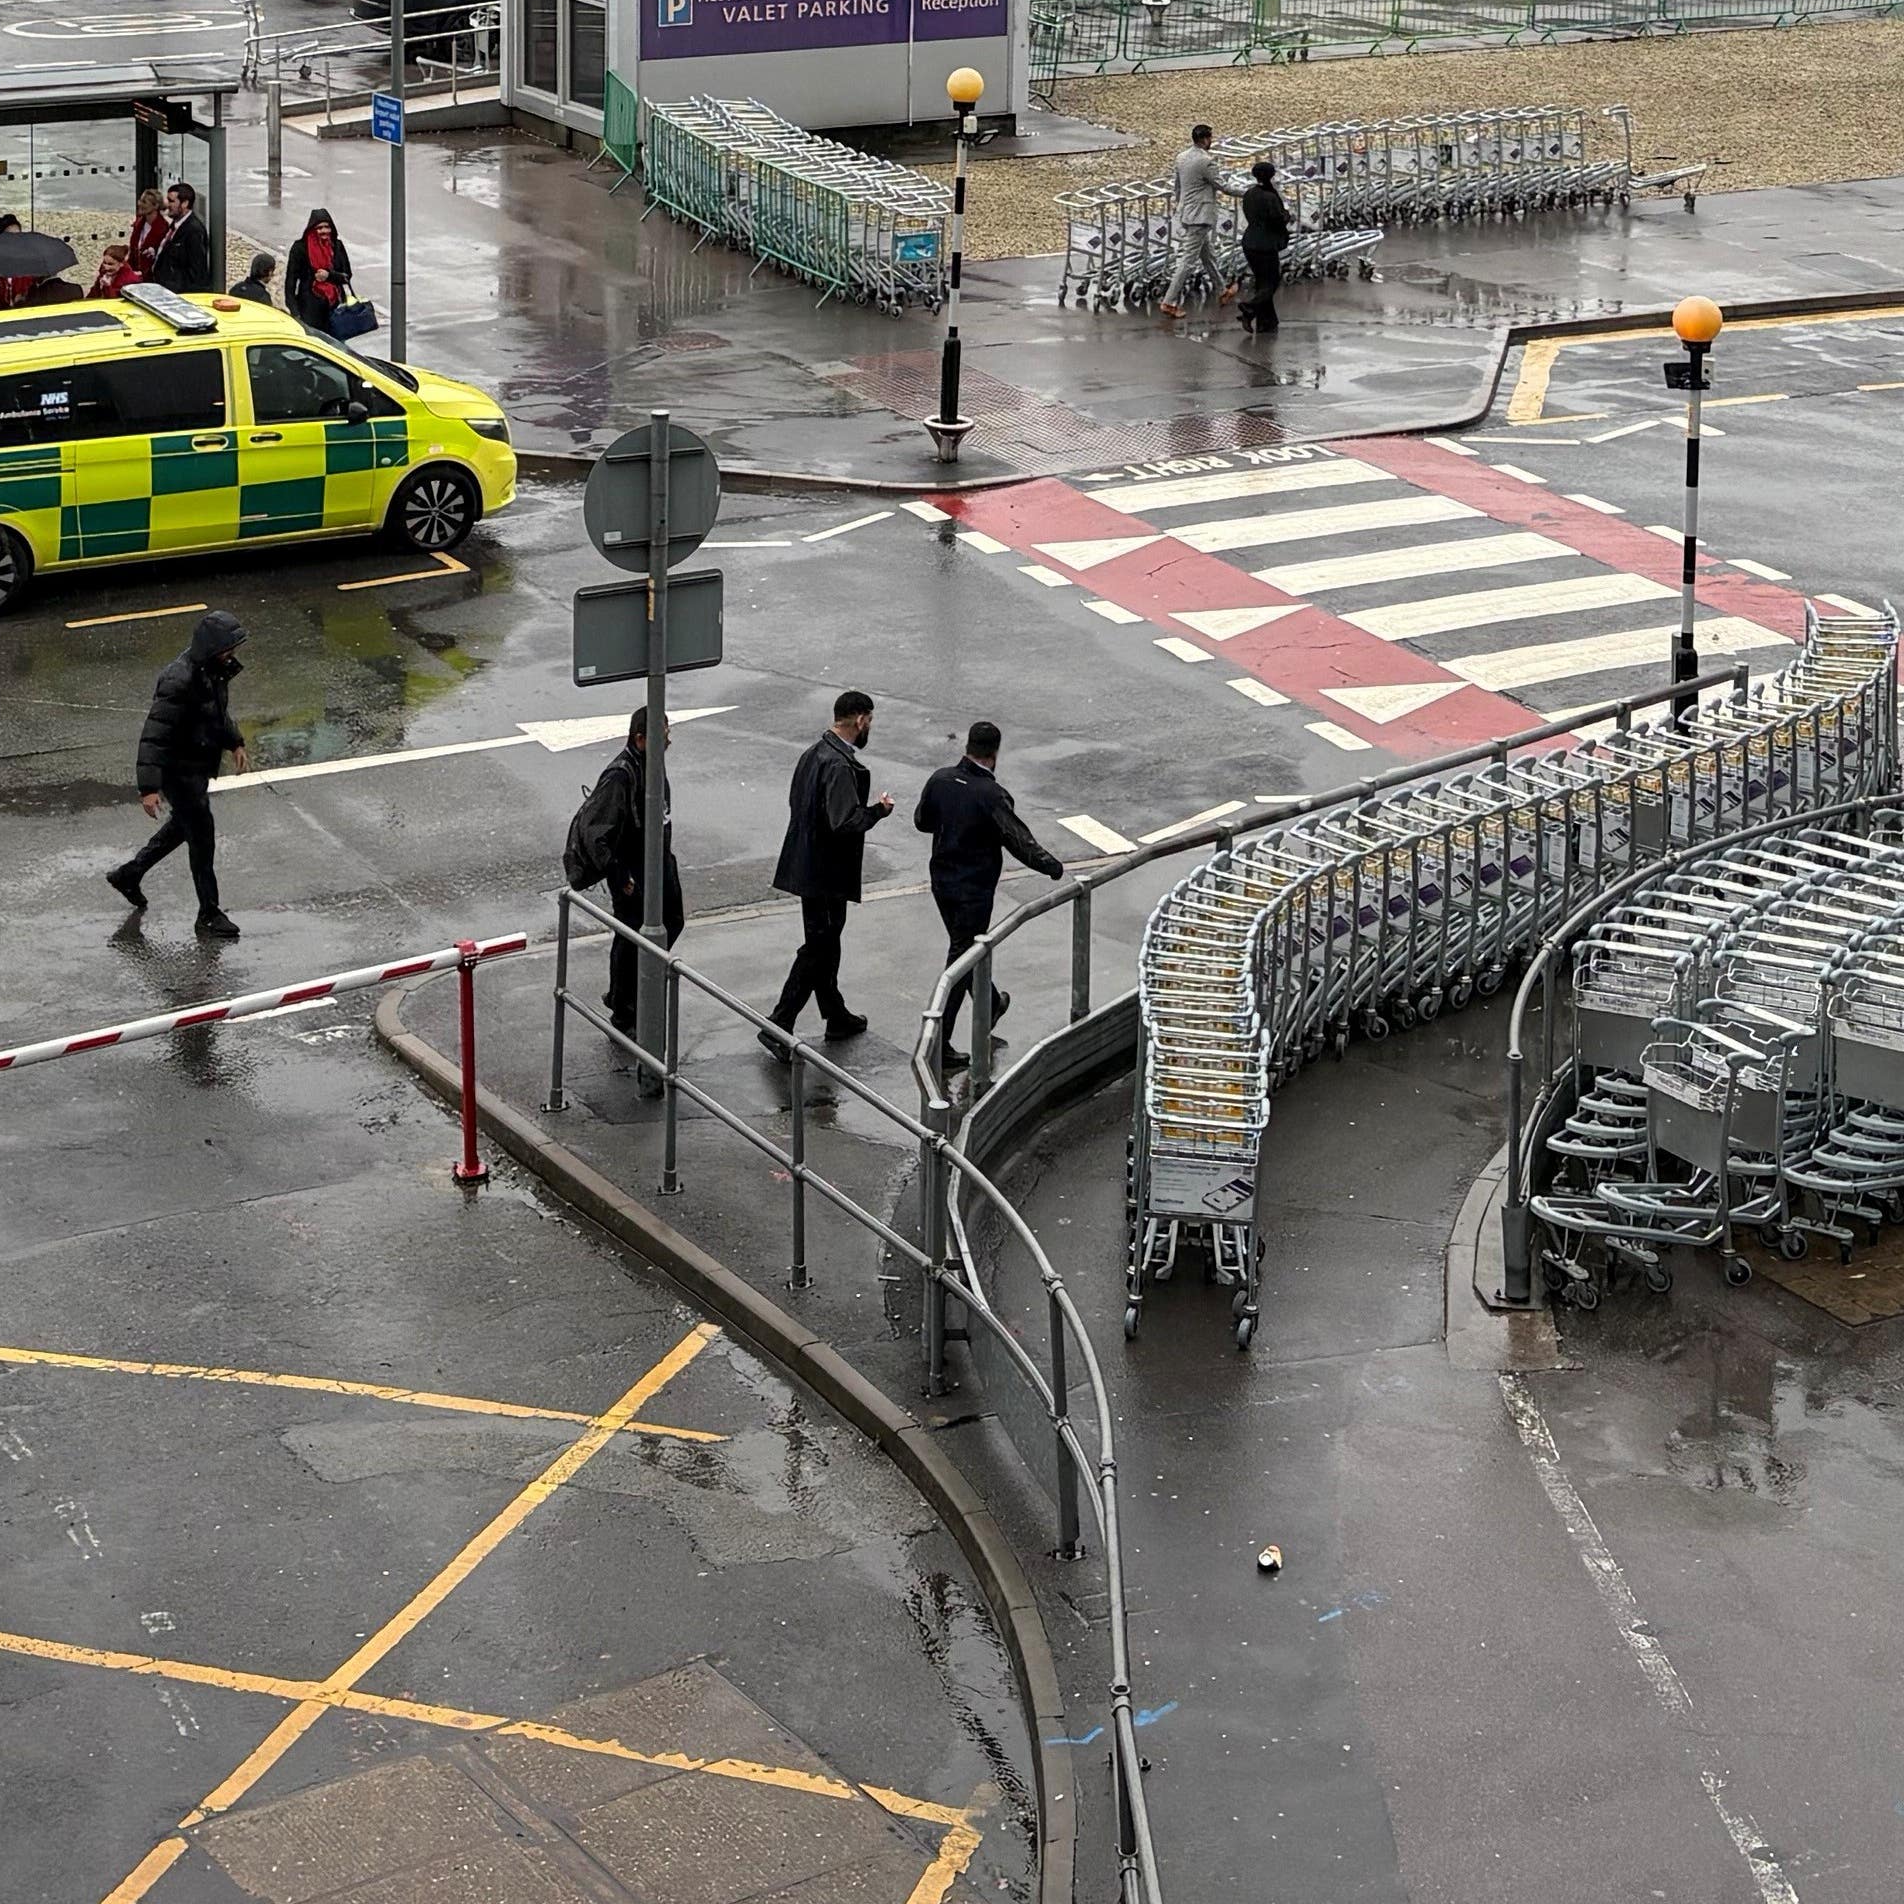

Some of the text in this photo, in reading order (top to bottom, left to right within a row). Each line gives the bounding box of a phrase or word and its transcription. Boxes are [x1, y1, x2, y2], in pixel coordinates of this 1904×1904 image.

[723, 3, 789, 24] VALET
[40, 392, 69, 406] NHS
[0, 408, 42, 420] Ambulance
[1124, 444, 1338, 481] LOOK RIGHT
